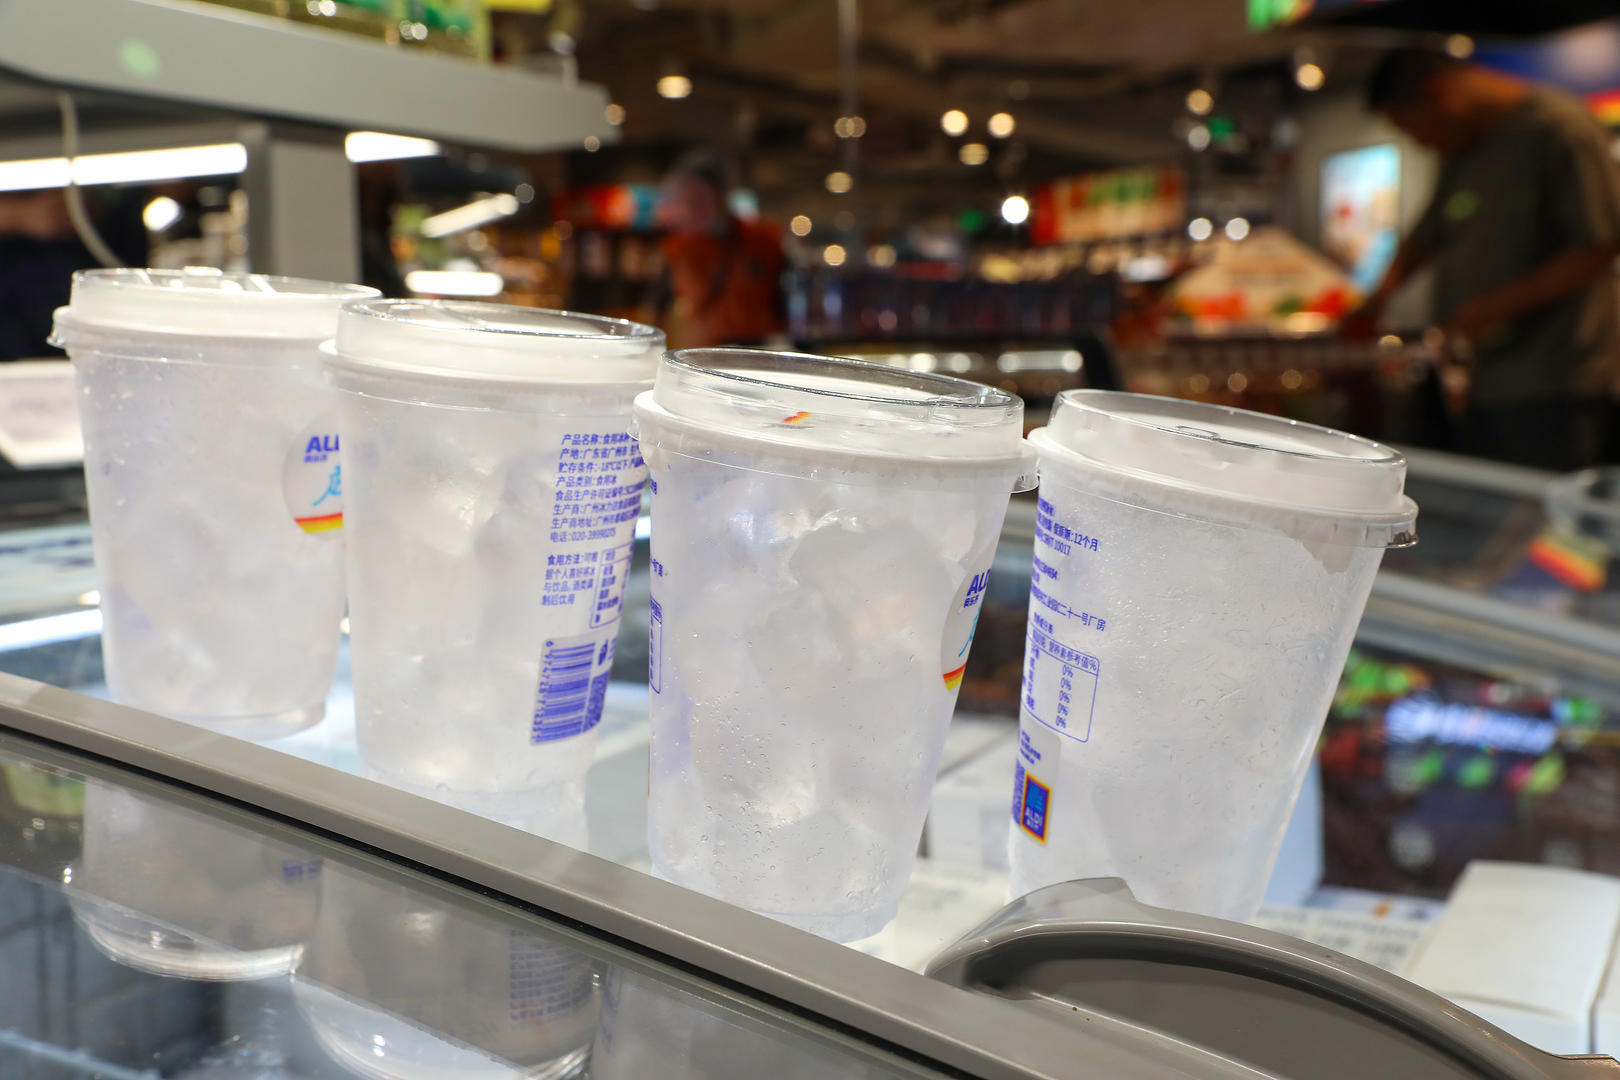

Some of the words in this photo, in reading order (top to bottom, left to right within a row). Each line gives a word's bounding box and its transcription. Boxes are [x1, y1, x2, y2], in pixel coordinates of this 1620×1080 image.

[305, 434, 340, 454] AL
[556, 475, 617, 488] 产品类别:食用冰
[1053, 522, 1099, 552] 保质期:12个月
[541, 593, 575, 606] 制后饮用
[1048, 640, 1098, 672] 营养素参考值%
[1062, 664, 1074, 678] 0%
[1060, 677, 1072, 691] 0%
[1058, 690, 1070, 703] 0%
[1057, 702, 1069, 716] 0%
[1055, 715, 1067, 728] 0%
